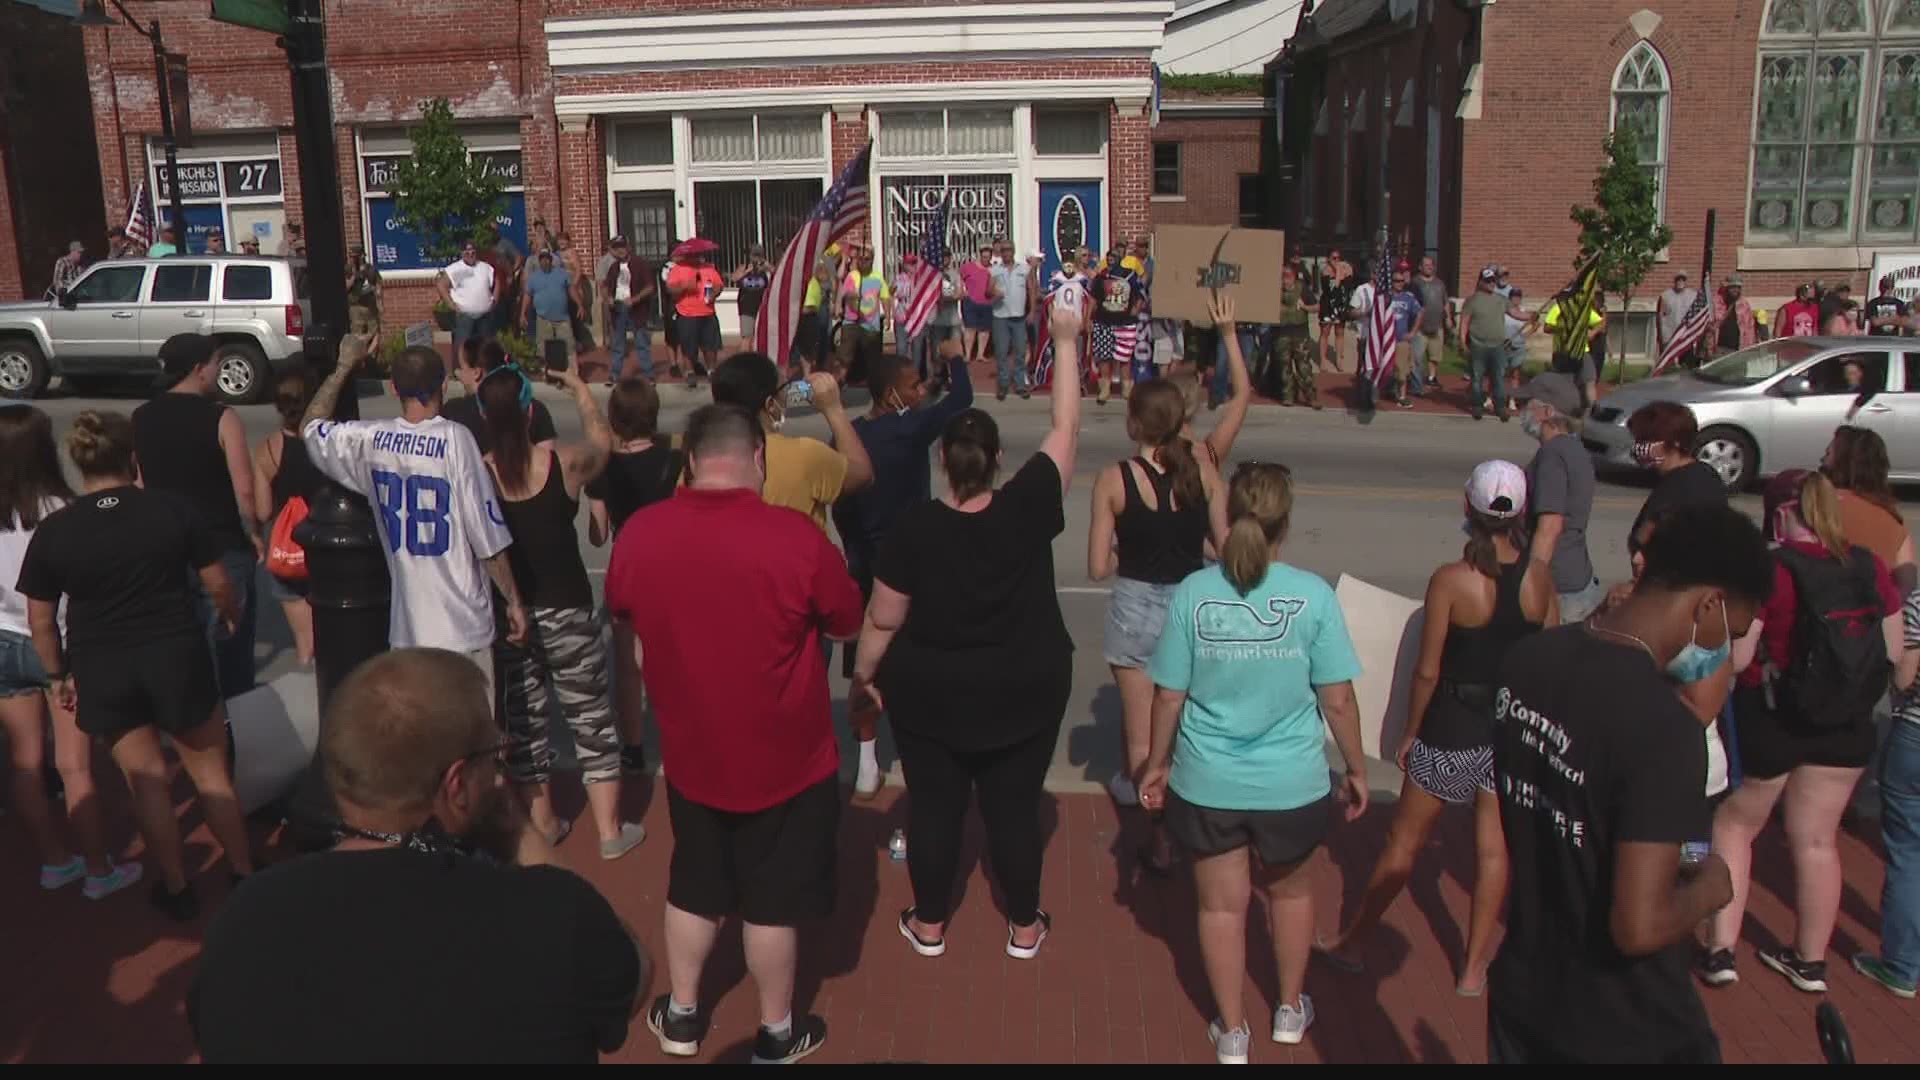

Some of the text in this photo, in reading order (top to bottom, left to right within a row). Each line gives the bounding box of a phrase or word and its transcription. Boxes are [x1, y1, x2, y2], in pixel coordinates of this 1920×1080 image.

[160, 166, 216, 180] CRCHES
[240, 165, 268, 190] 27
[887, 186, 1006, 213] NICHOLS
[888, 219, 1005, 237] INSUANCE
[373, 430, 447, 460] HARRISON
[371, 469, 451, 557] 88
[1509, 700, 1572, 754] Comnity
